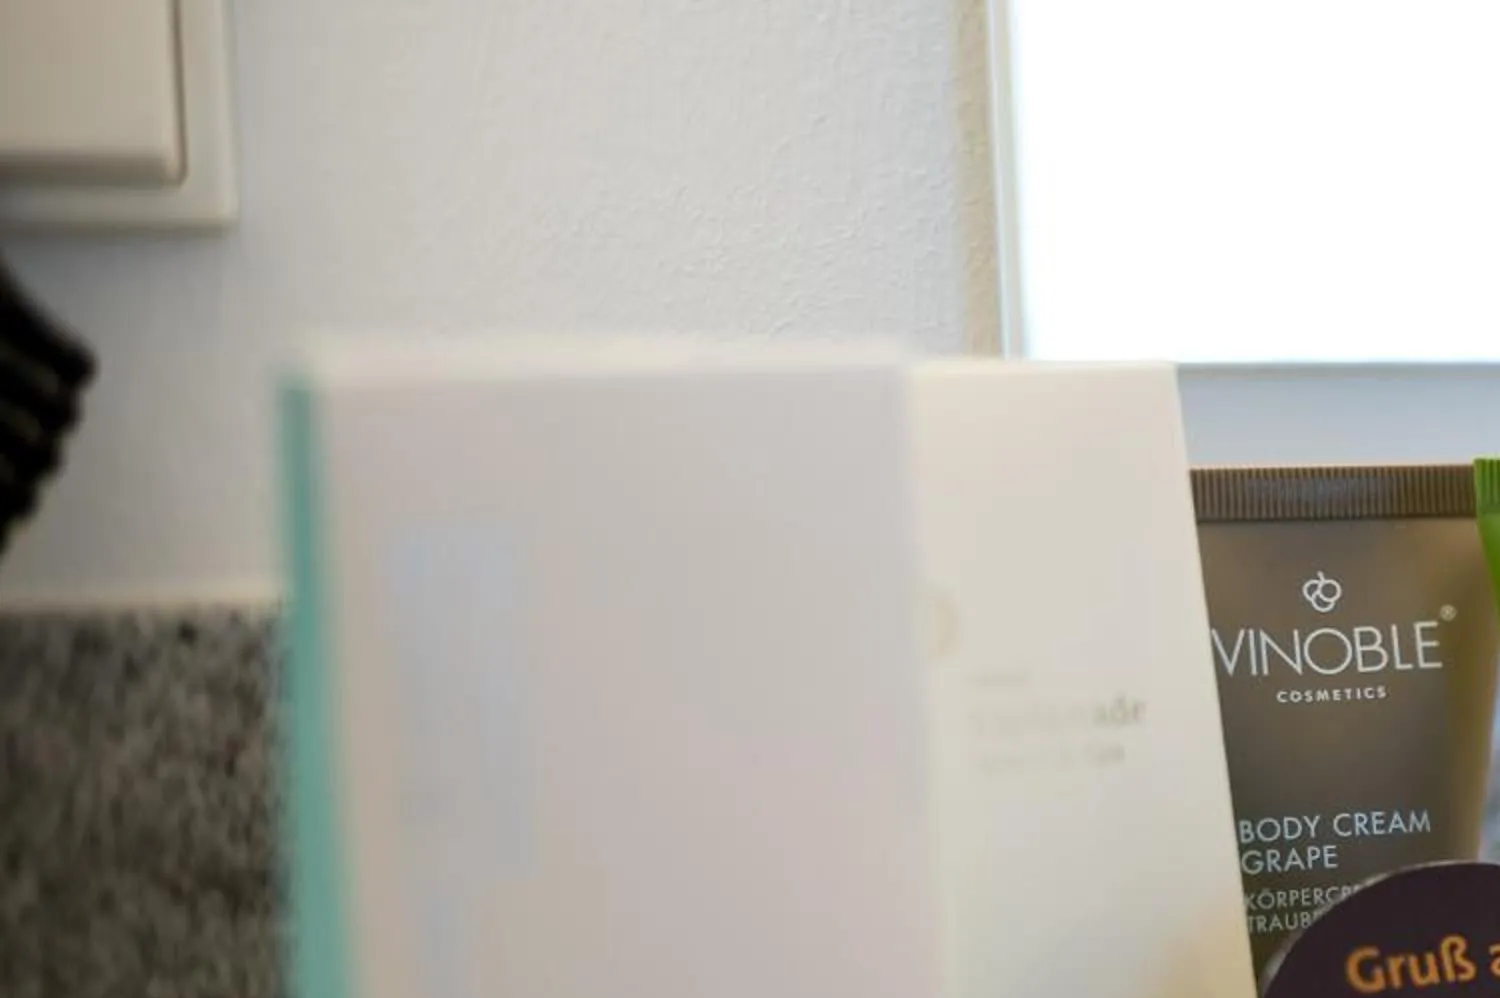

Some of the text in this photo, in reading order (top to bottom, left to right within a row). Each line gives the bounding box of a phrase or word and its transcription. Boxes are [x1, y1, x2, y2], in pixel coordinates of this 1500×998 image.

[1210, 619, 1443, 676] VINOBLE
[1276, 685, 1388, 703] COSMETICS
[1239, 808, 1432, 844] BODY CREAM
[1240, 844, 1339, 876] GRAPE
[1344, 935, 1477, 993] Gruß
